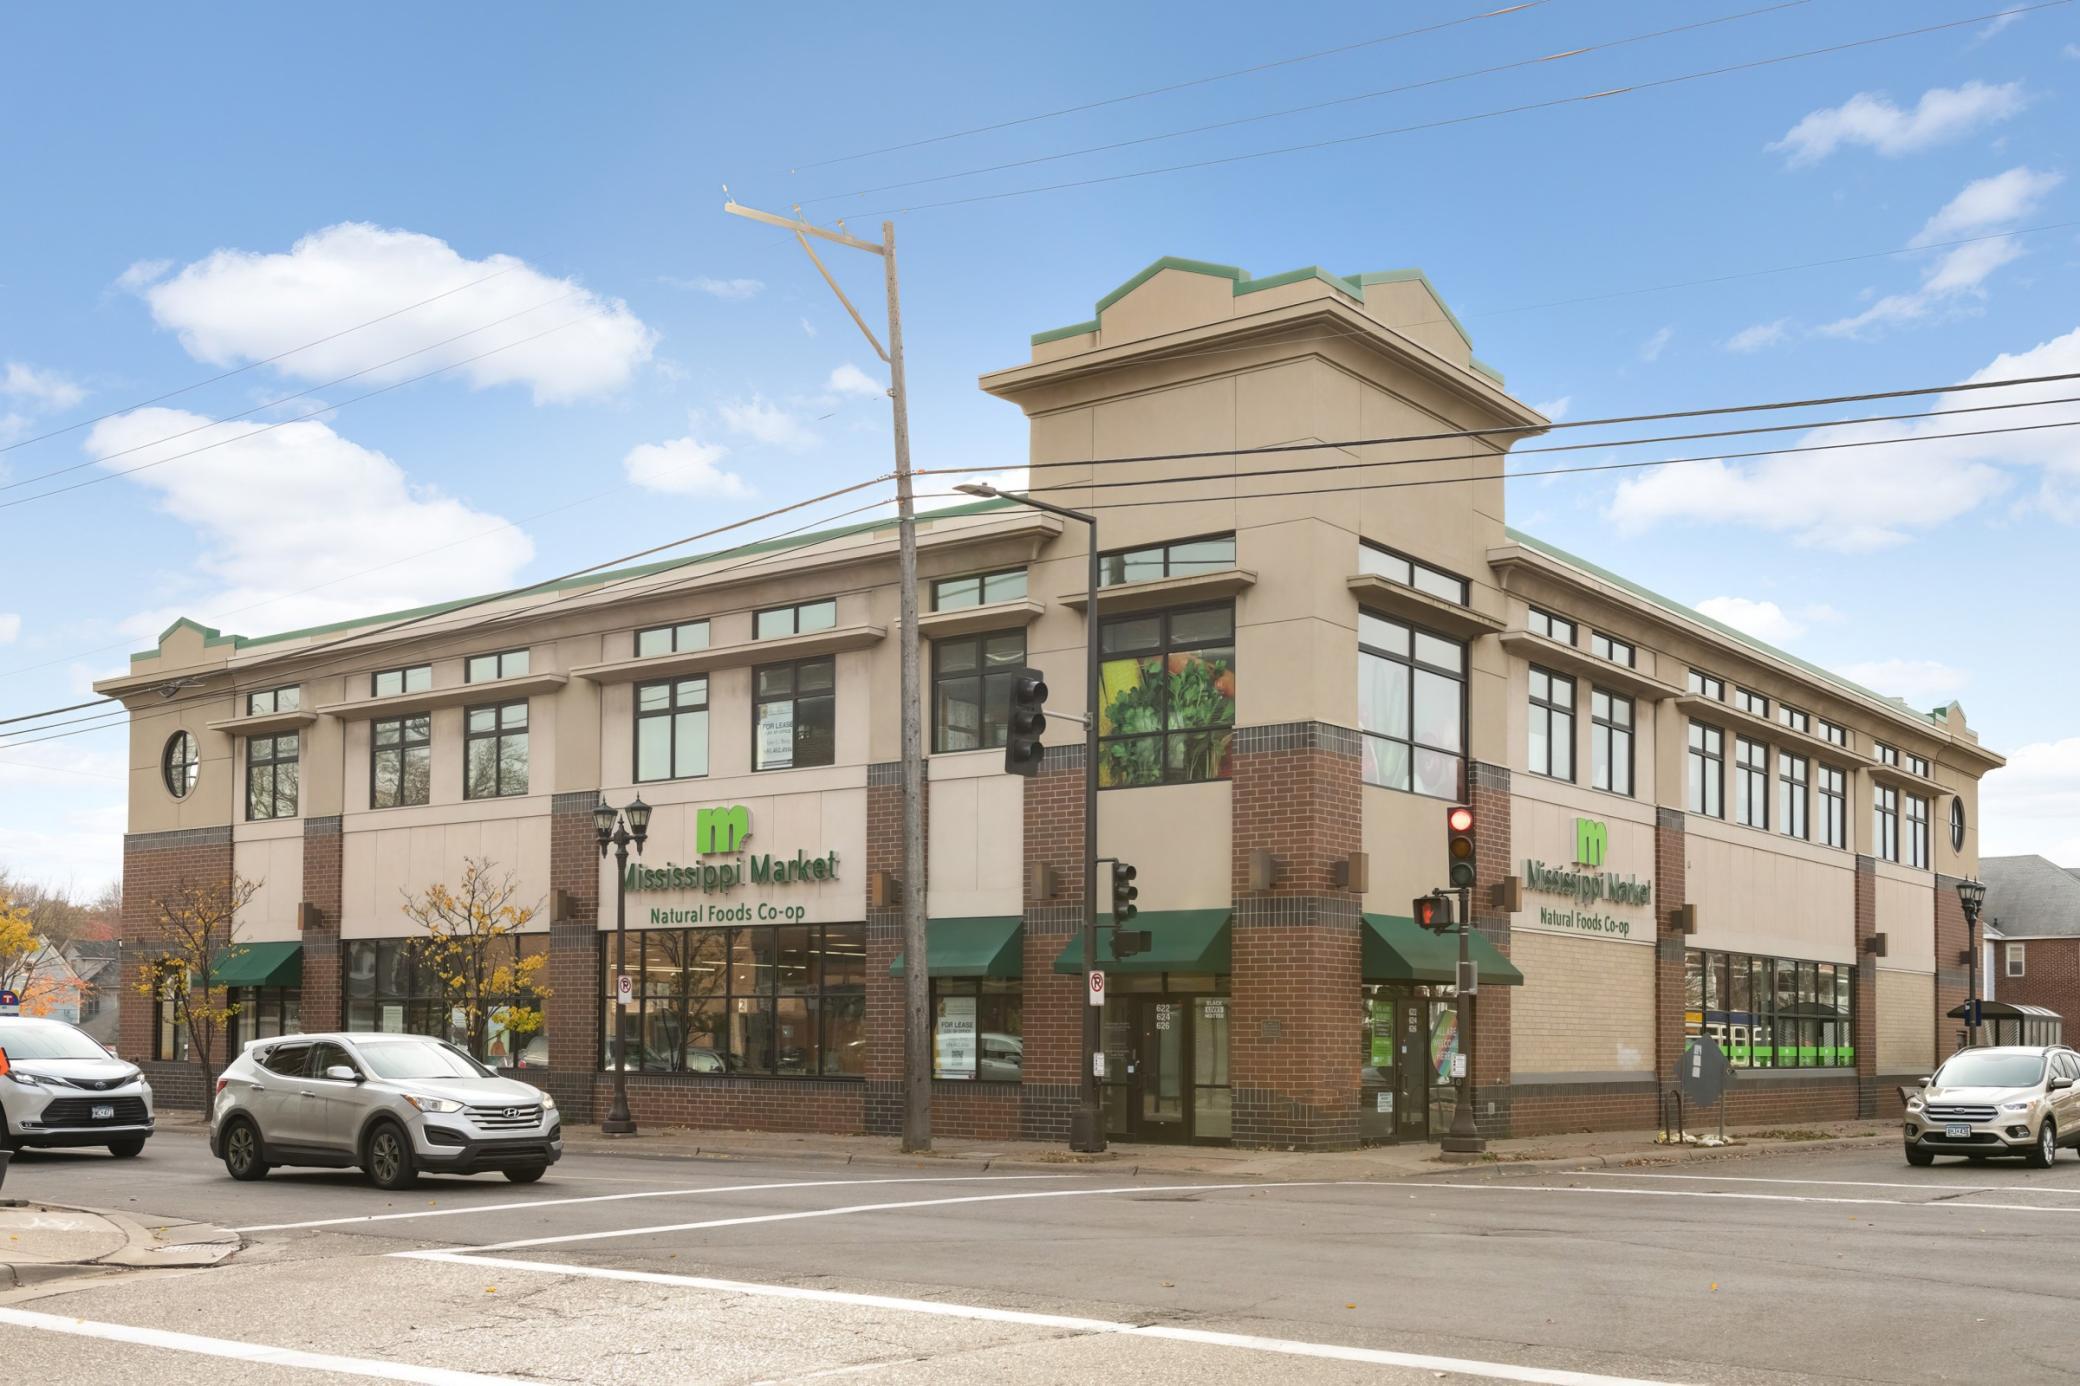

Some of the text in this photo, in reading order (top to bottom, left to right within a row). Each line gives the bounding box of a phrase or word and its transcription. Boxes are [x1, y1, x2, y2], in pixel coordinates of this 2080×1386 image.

[751, 849, 839, 883] Market
[1526, 859, 1651, 905] Mississippi Market
[651, 902, 805, 924] Natural Foods Co-op
[1540, 907, 1630, 938] Natural Foods Co-op
[1156, 1004, 1170, 1012] 622
[1156, 1012, 1171, 1021] 624
[941, 1021, 973, 1029] FOR LEASE
[1156, 1021, 1170, 1030] 626
